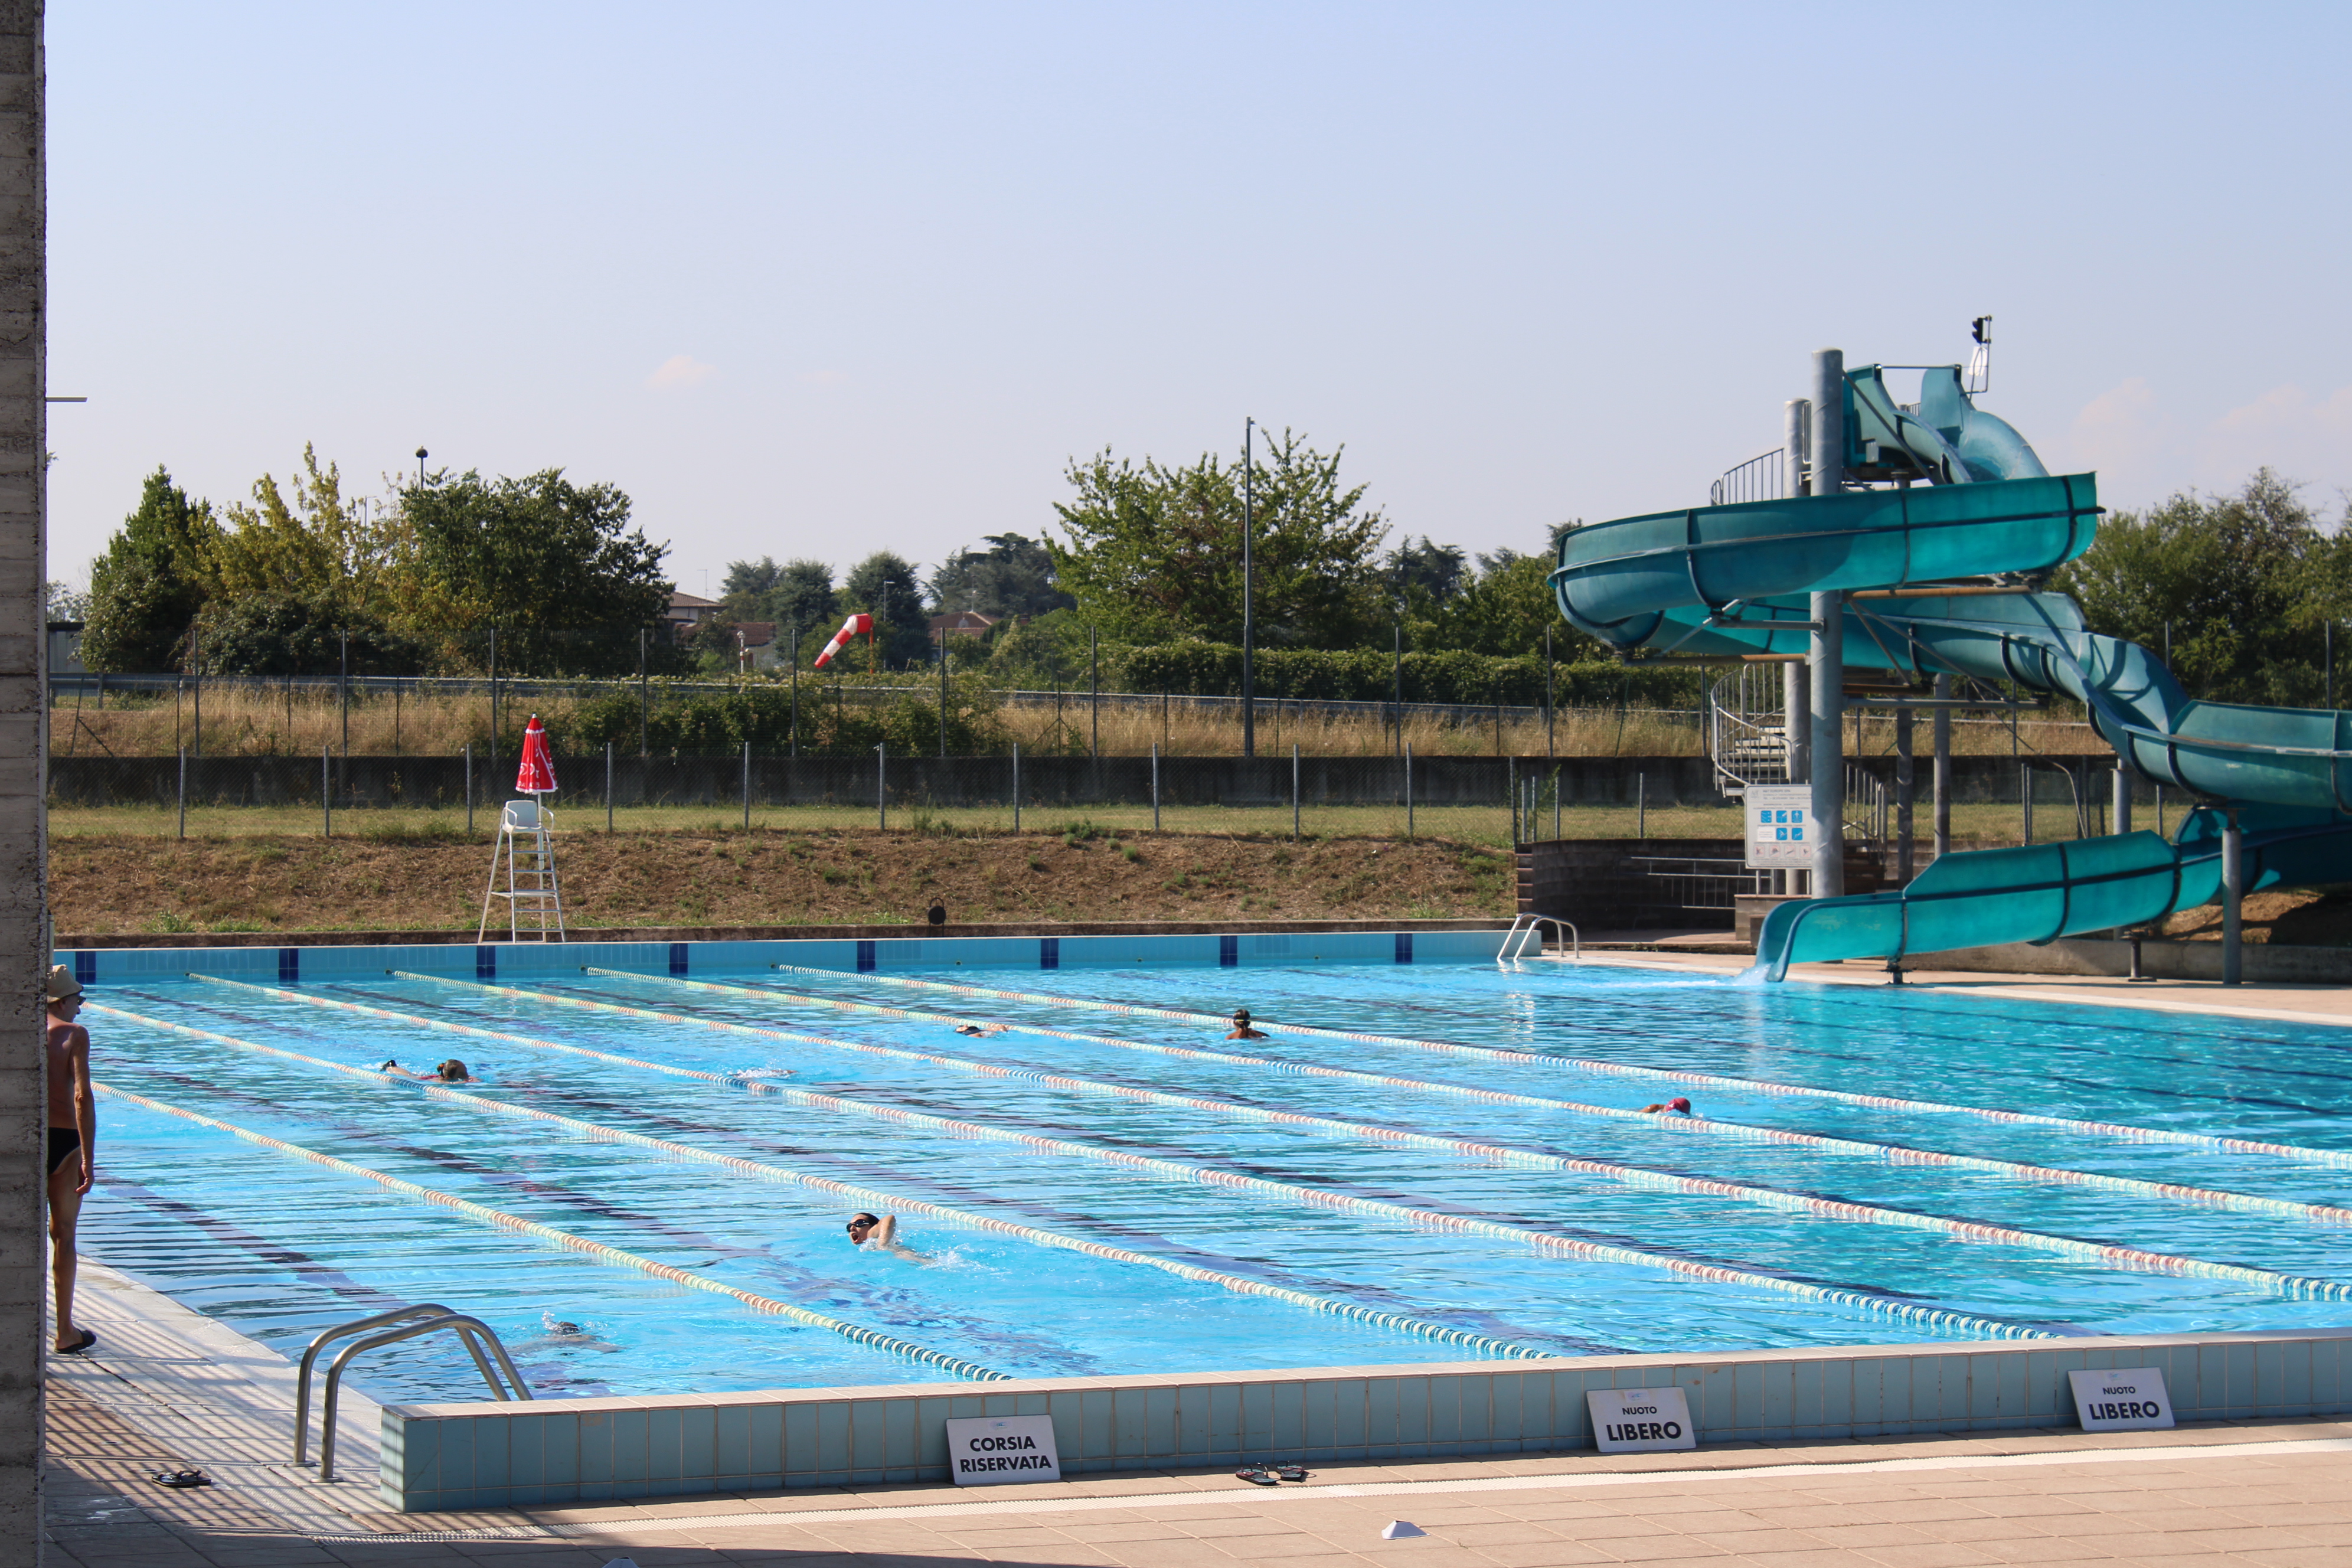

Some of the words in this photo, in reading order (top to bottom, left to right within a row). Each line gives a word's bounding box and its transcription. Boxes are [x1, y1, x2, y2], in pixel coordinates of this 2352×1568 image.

[2102, 1386, 2136, 1395] NUOTO
[1622, 1406, 1657, 1415] NUOTO
[2088, 1401, 2160, 1420] LIBERO
[1606, 1421, 1681, 1441] LIBERO
[969, 1436, 1037, 1452] CORSIA
[959, 1455, 1052, 1472] RISERVATA
